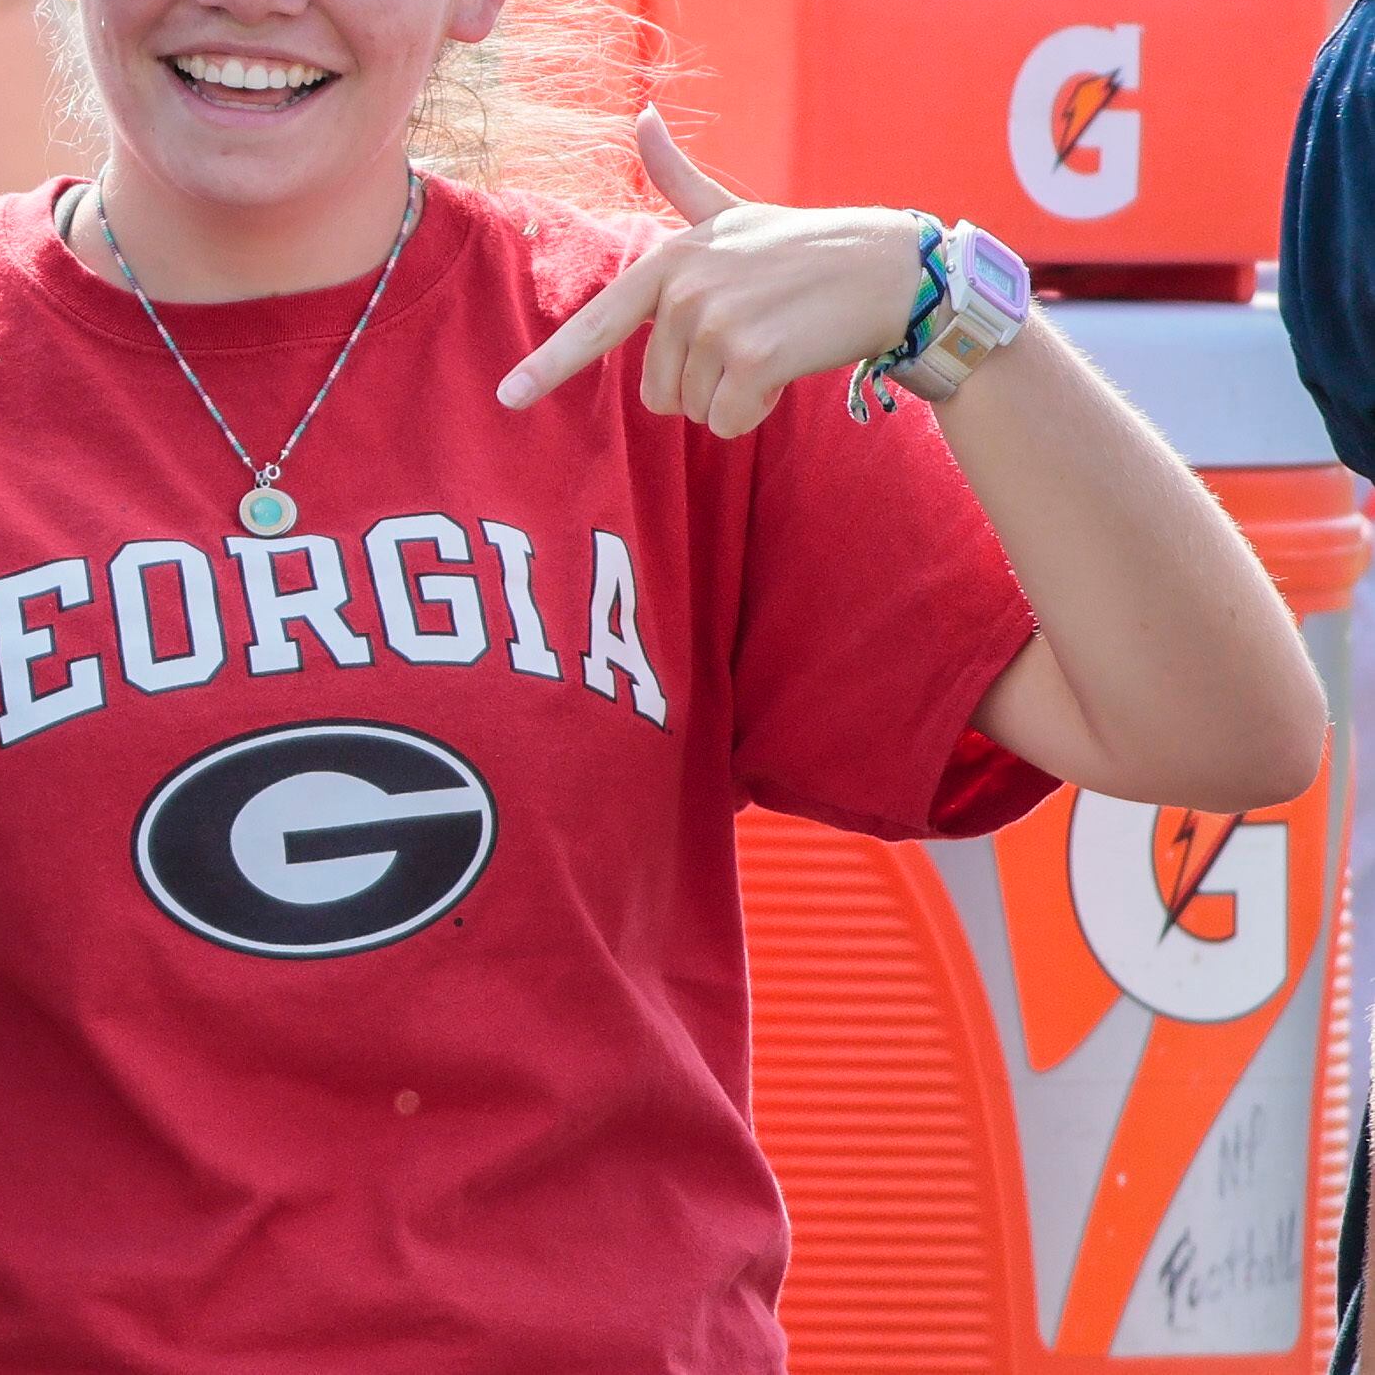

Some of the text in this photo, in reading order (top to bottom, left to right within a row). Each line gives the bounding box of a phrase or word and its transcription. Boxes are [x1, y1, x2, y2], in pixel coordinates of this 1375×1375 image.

[1007, 24, 1144, 220] G
[229, 770, 485, 906] G
[1067, 785, 1288, 1025] G
